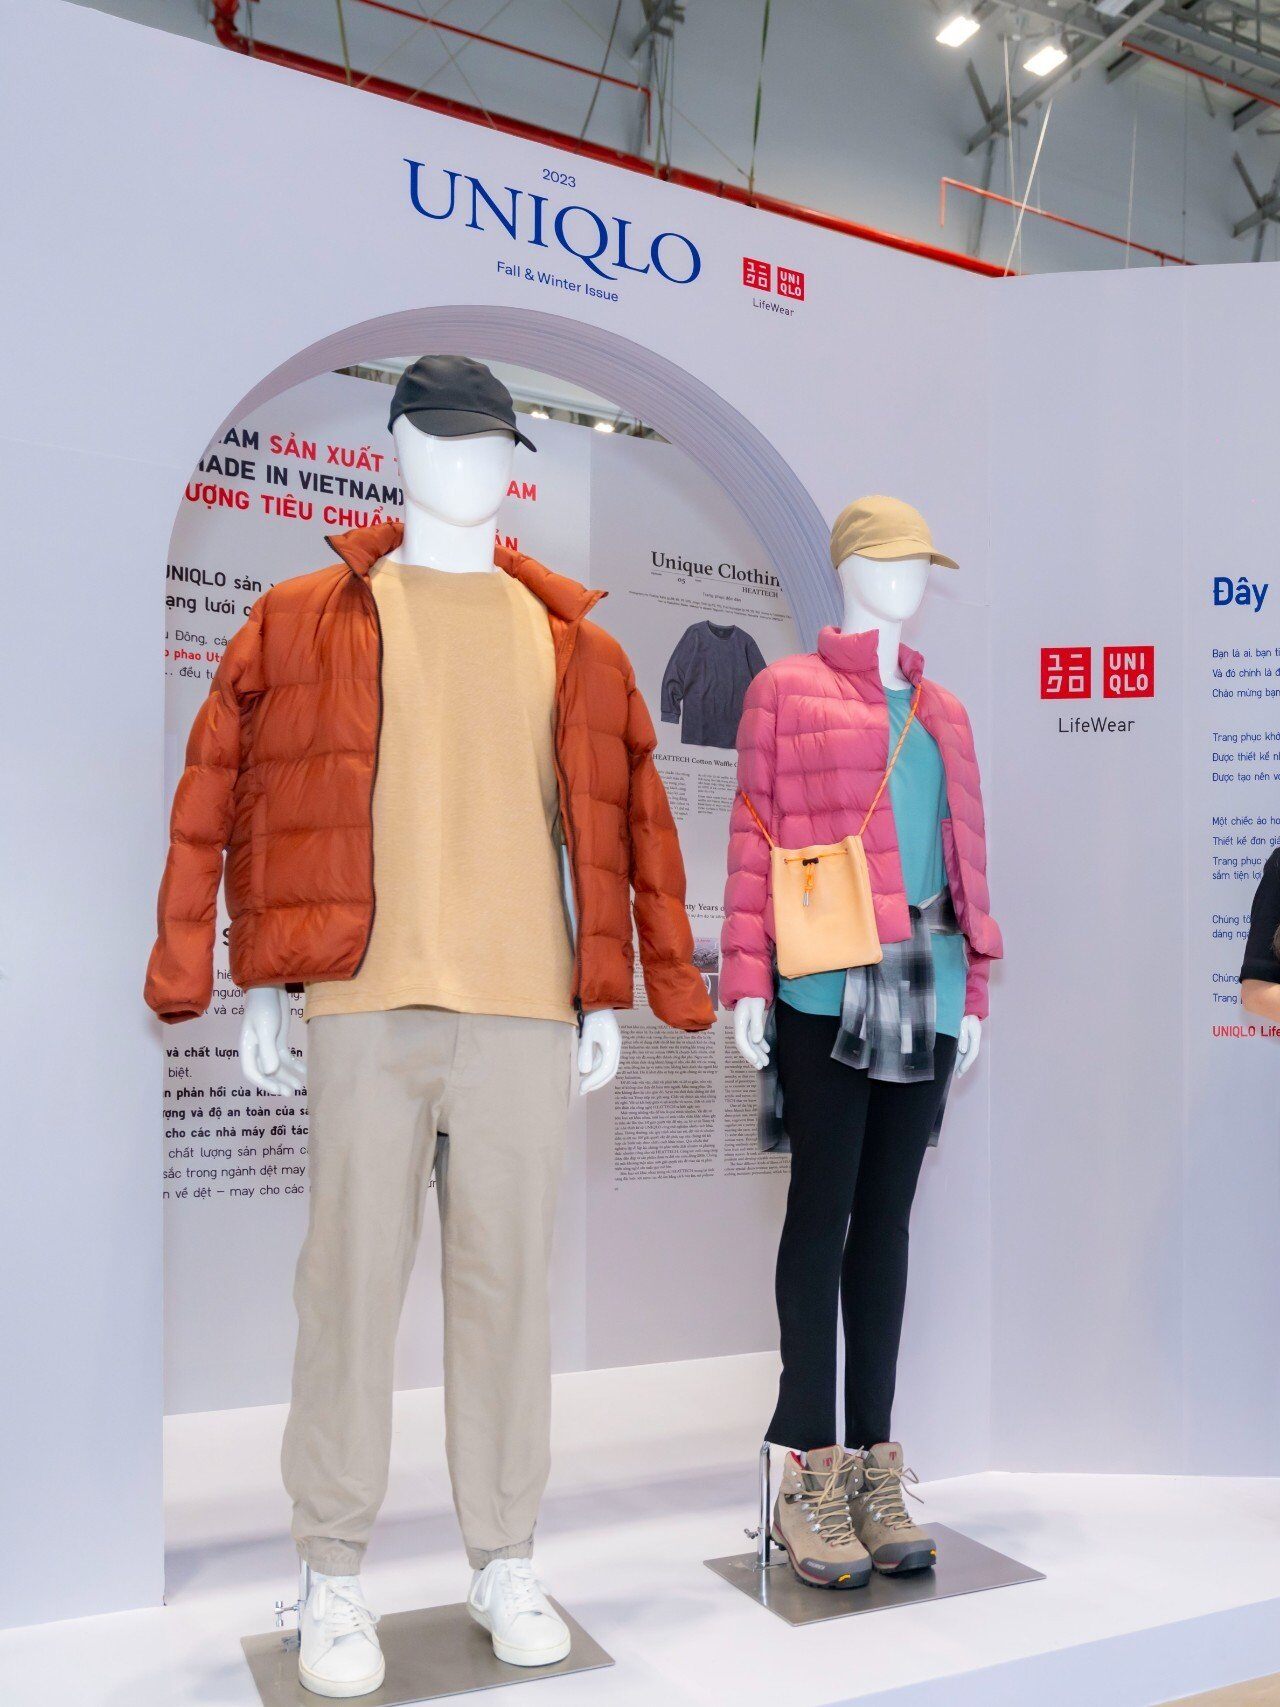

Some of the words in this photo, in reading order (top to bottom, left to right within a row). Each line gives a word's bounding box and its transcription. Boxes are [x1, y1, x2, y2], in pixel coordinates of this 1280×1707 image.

[542, 168, 576, 188] 2023
[403, 158, 701, 284] UNIQLO
[497, 260, 522, 278] Fall
[524, 267, 535, 281] &
[537, 270, 581, 294] Winter
[585, 282, 619, 302] Issue
[752, 298, 795, 317] LifeWear
[221, 427, 259, 451] AM
[270, 432, 317, 461] SẢN
[327, 446, 384, 472] XUẤT
[199, 455, 256, 481] ADE
[266, 464, 288, 487] IN
[299, 470, 405, 506] VIETNAM)
[506, 480, 537, 502] AM
[185, 482, 250, 510] ƯỢNG
[261, 493, 313, 521] TIÊU
[651, 550, 713, 577] Unique
[718, 562, 782, 589] Clothin
[234, 575, 262, 592] sản
[742, 586, 779, 599] HEATTECH
[1213, 576, 1269, 612] Đây
[165, 595, 197, 613] ạng
[205, 596, 235, 615] lưới
[174, 648, 202, 661] phao
[1109, 652, 1145, 671] UNI
[1109, 673, 1149, 695] QLO
[1058, 717, 1136, 733] LifeWear
[653, 753, 690, 764] HEATTECH
[214, 1004, 227, 1015] và
[1212, 1026, 1256, 1038] UNIQLO
[166, 1046, 179, 1058] và
[184, 1045, 211, 1058] chất
[215, 1046, 239, 1060] lượn
[168, 1066, 192, 1080] biệt.
[176, 1087, 204, 1100] phản
[210, 1086, 227, 1098] hồi
[231, 1086, 251, 1097] của
[163, 1108, 186, 1120] ợng
[191, 1107, 204, 1118] và
[208, 1106, 222, 1120] độ
[227, 1108, 241, 1117] an
[246, 1106, 271, 1117] toàn
[275, 1105, 295, 1117] của
[165, 1128, 186, 1139] cho
[191, 1126, 211, 1138] các
[216, 1126, 237, 1137] nhà
[241, 1124, 266, 1139] máy
[270, 1124, 287, 1136] đối
[291, 1124, 309, 1136] tác
[168, 1146, 194, 1159] chất
[200, 1147, 232, 1160] lượng
[237, 1145, 257, 1157] sản
[262, 1143, 295, 1158] phẩm
[163, 1166, 182, 1179] sắc
[186, 1167, 217, 1180] trong
[221, 1165, 256, 1180] ngành
[259, 1164, 278, 1178] dệt
[281, 1165, 306, 1177] may
[175, 1187, 189, 1199] về
[193, 1187, 212, 1200] dệt
[229, 1187, 255, 1198] may
[259, 1185, 280, 1195] cho
[284, 1183, 305, 1195] các
